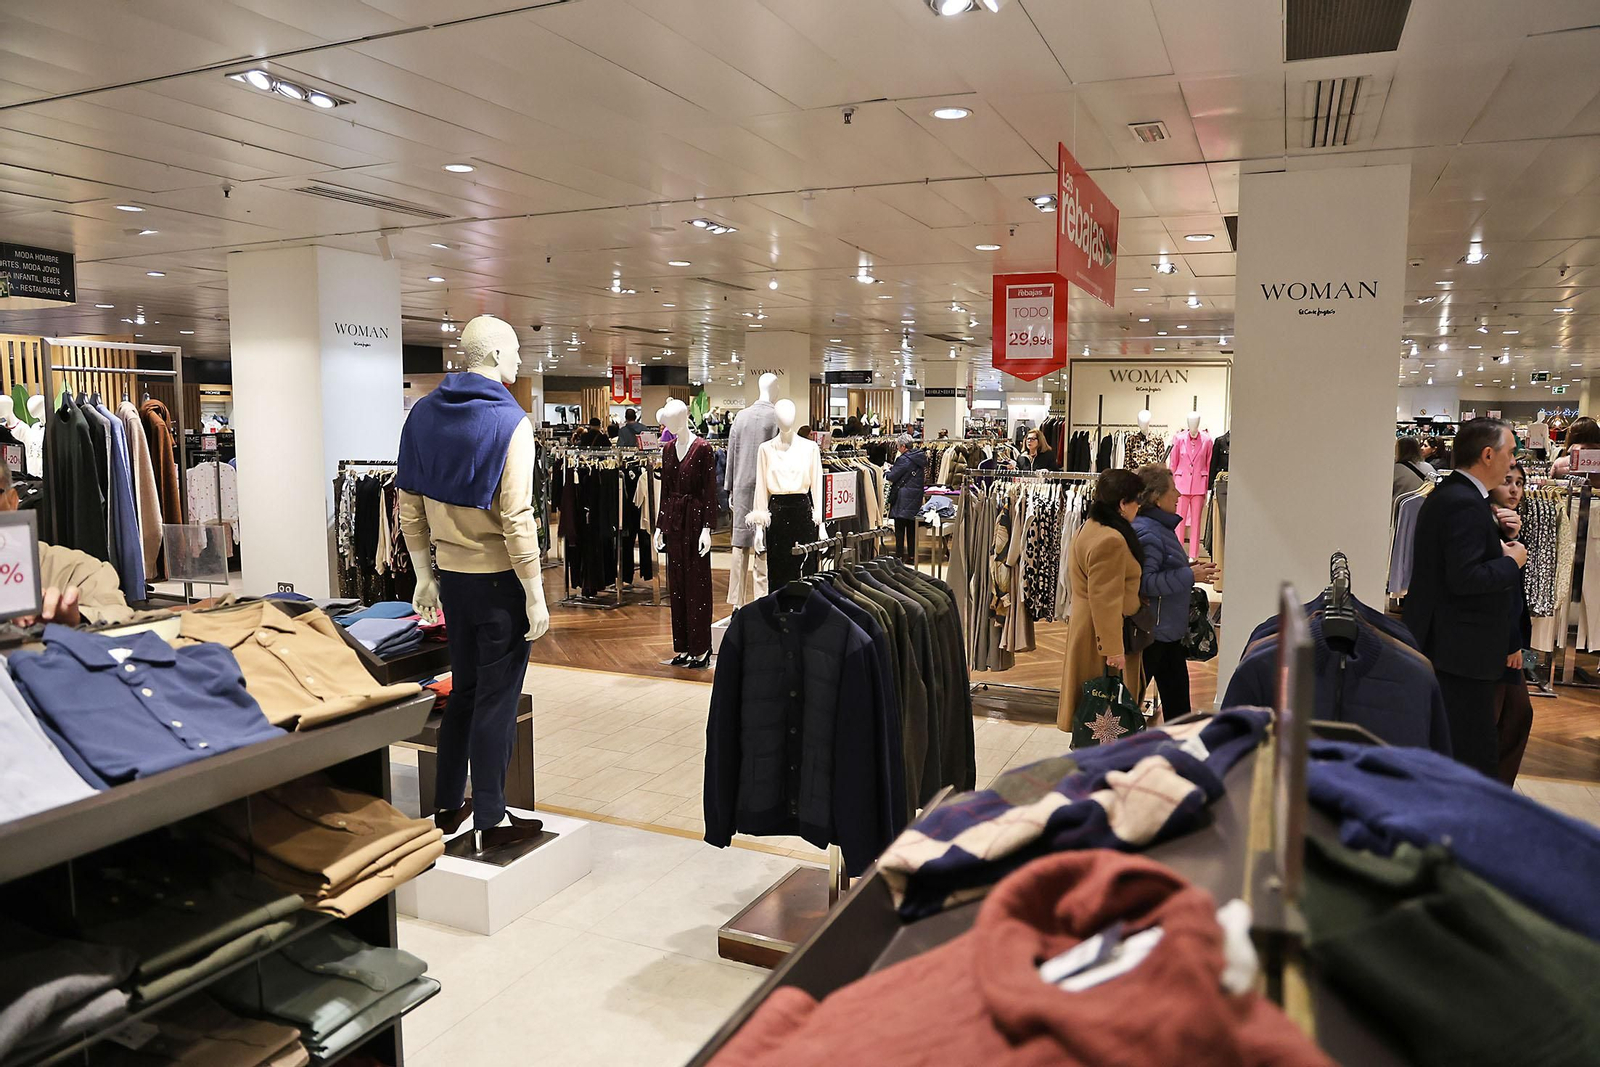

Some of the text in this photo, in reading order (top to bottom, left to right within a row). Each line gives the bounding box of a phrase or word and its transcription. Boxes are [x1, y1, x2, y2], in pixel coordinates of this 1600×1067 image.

[1062, 161, 1074, 194] Las
[1061, 187, 1105, 269] rebajas
[14, 250, 59, 264] MODA HOMBRE
[22, 262, 41, 272] MODA
[42, 265, 60, 274] JOVEN
[20, 284, 61, 296] RESTAURANTE
[1017, 289, 1043, 297] rebajas
[1260, 281, 1378, 301] WOMAN
[1012, 306, 1049, 318] TODO
[334, 322, 389, 339] WOMAN
[1109, 369, 1189, 384] WOMAN
[834, 489, 854, 505] -30%
